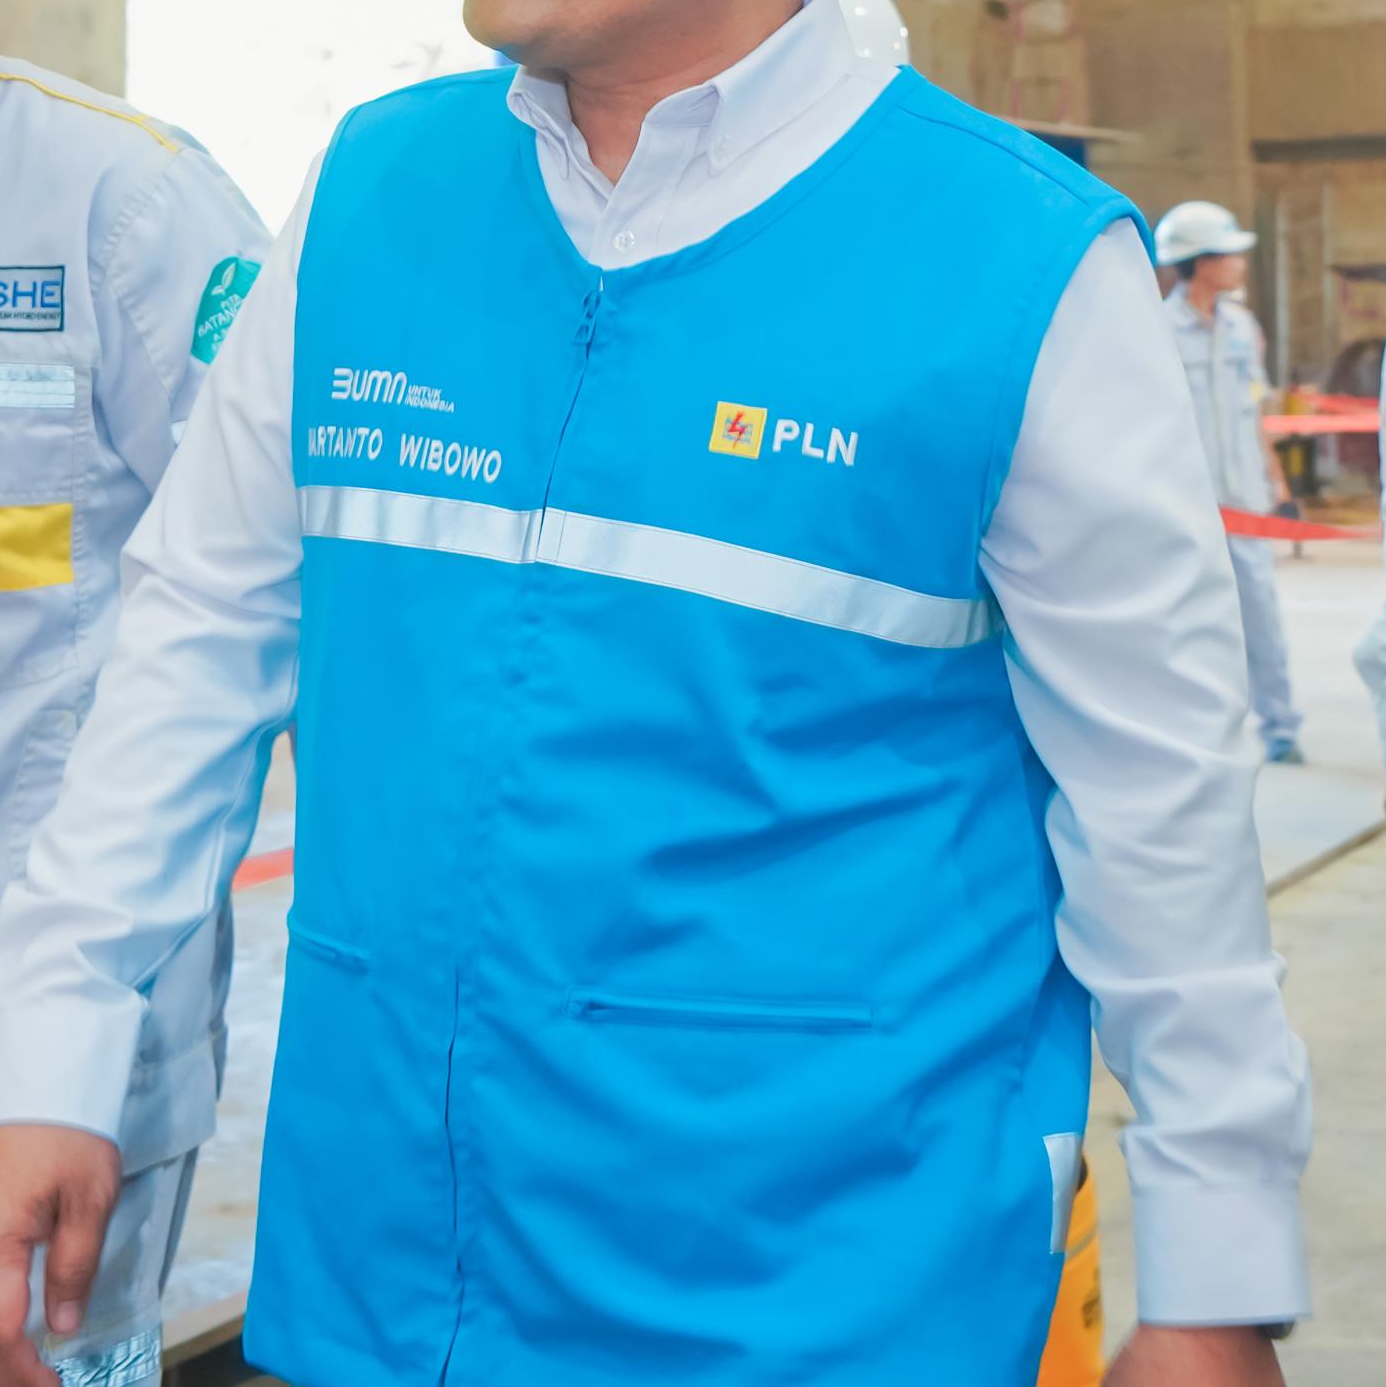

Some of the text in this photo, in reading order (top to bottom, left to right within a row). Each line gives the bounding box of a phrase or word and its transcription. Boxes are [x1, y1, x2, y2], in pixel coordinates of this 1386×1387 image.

[408, 385, 441, 399] UNTUK
[399, 433, 502, 484] WIBOWO
[772, 419, 859, 467] PLN
